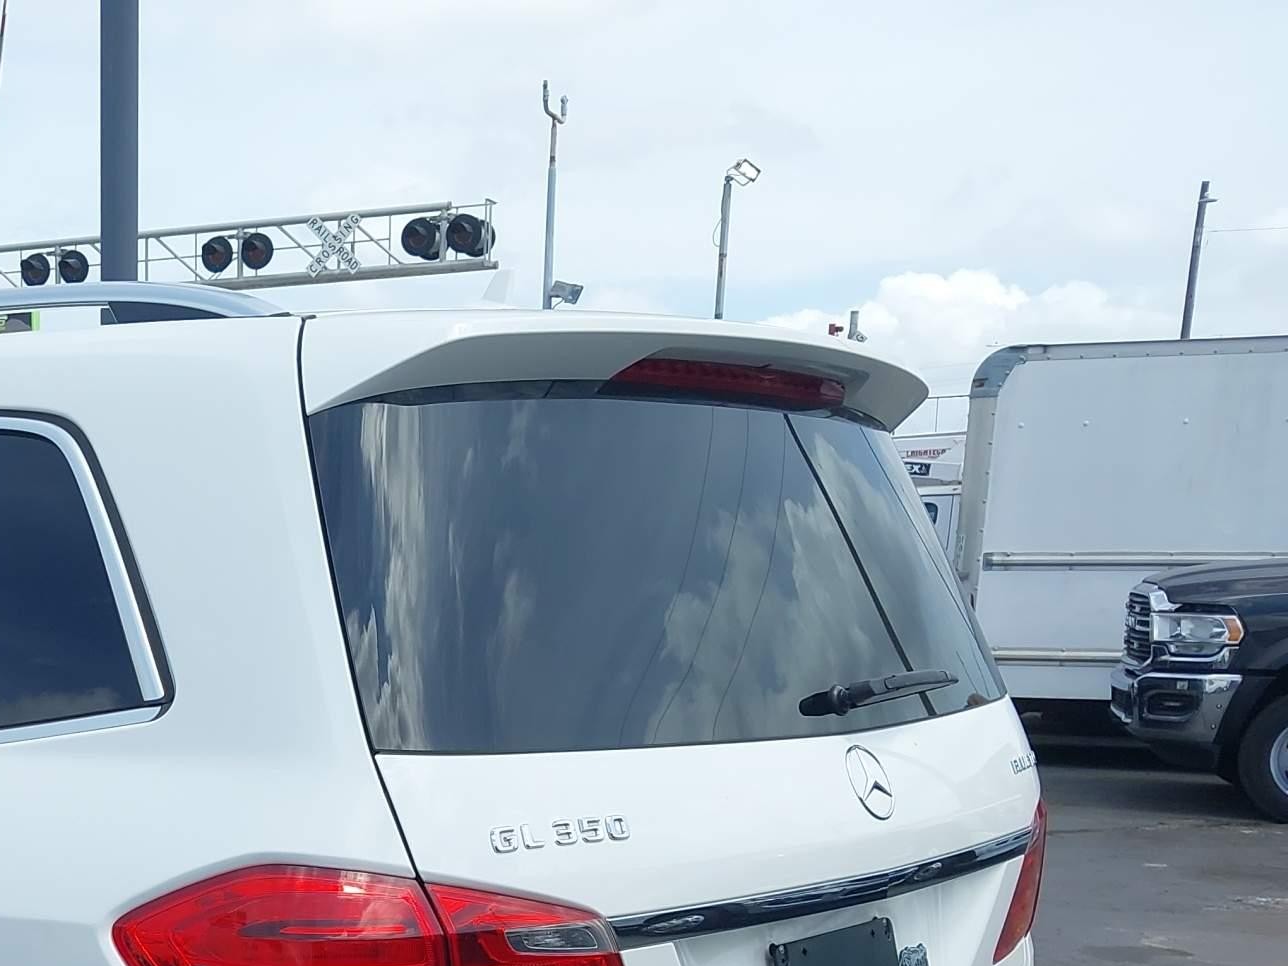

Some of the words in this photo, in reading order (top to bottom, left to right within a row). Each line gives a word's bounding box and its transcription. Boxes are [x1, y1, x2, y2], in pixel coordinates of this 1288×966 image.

[309, 215, 359, 273] CROSSING
[489, 824, 545, 854] GL
[551, 814, 630, 847] 350
